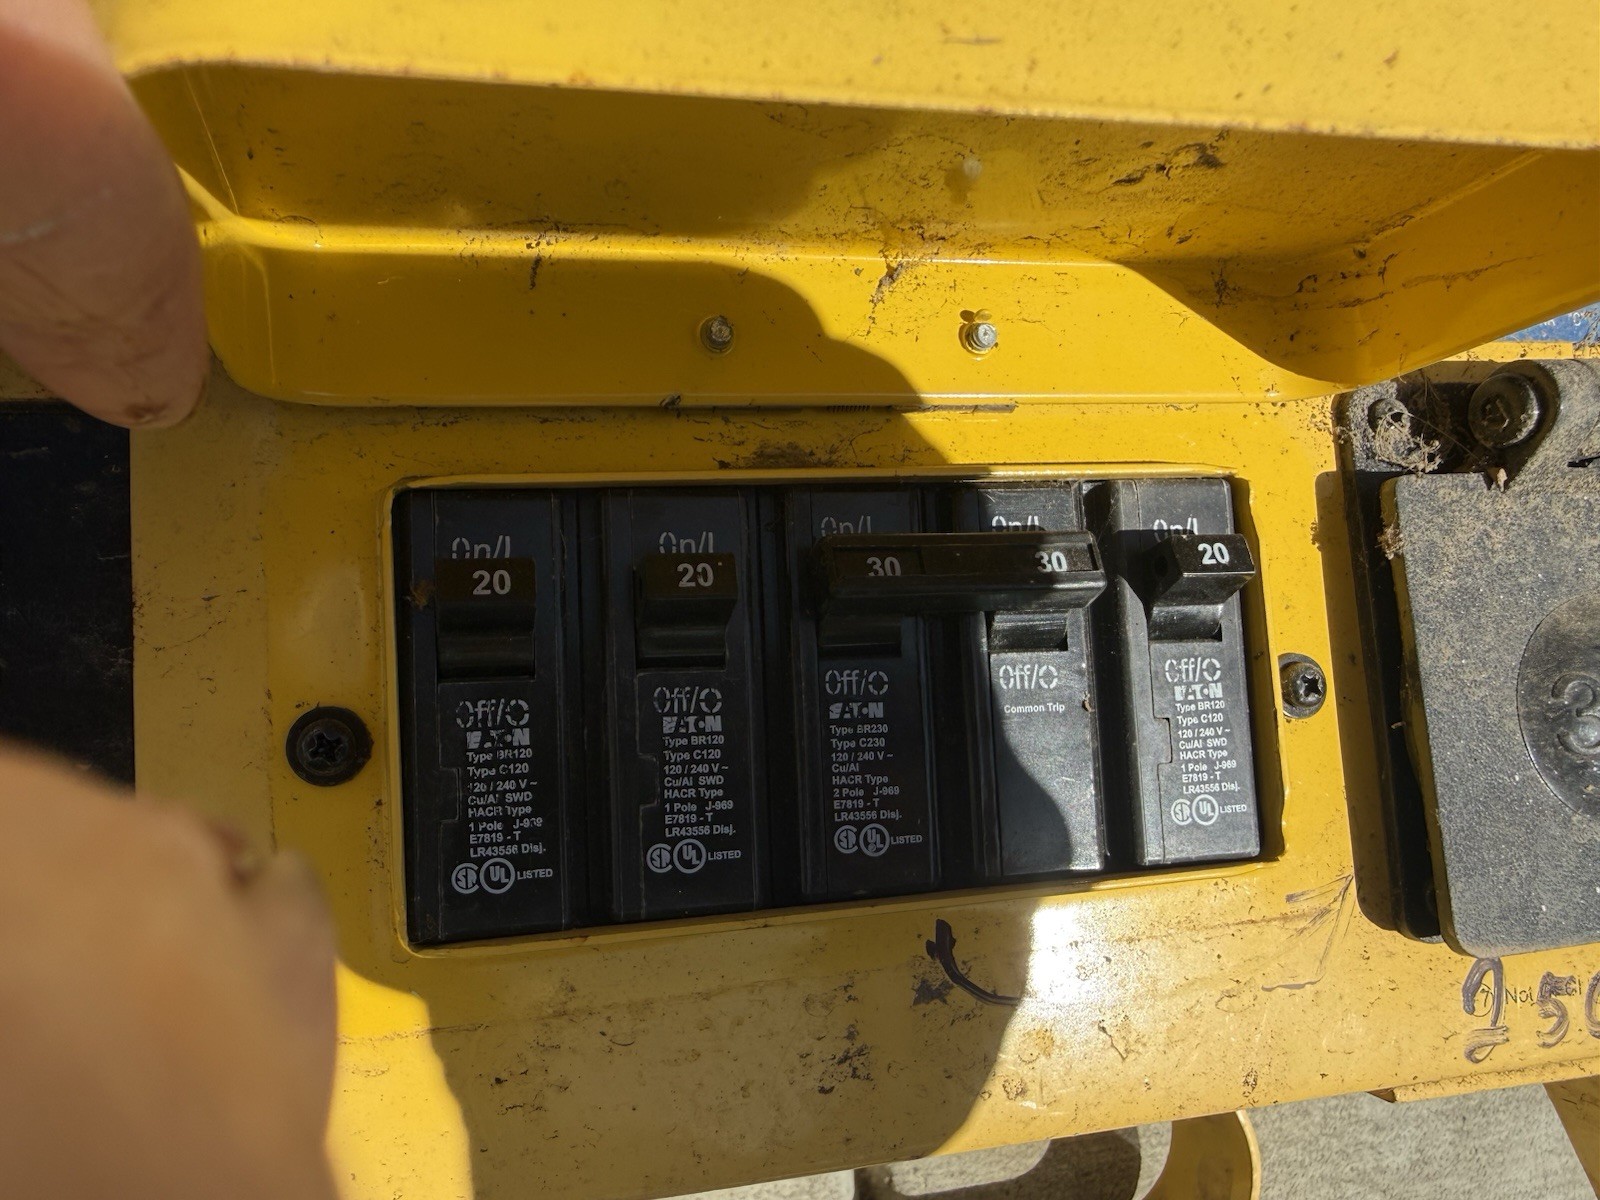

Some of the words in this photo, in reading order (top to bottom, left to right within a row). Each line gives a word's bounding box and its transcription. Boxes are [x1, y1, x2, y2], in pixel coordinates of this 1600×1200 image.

[1198, 543, 1230, 565] 20
[866, 556, 902, 577] 30
[1035, 551, 1068, 572] 30
[676, 562, 714, 588] 20
[472, 569, 512, 595] 20
[1004, 704, 1045, 714] Common
[1047, 703, 1065, 714] Trip
[1174, 703, 1196, 714] Type
[1197, 700, 1225, 710] BR120
[1176, 716, 1199, 727] Type
[1200, 713, 1224, 723] C120
[829, 725, 854, 736] Type
[856, 723, 889, 734] BR230
[1178, 729, 1193, 738] 120
[1199, 727, 1215, 737] 240
[1216, 726, 1223, 736] V
[662, 736, 688, 748] Type
[690, 735, 725, 746] BR120
[830, 738, 856, 750] Type
[859, 737, 886, 748] C230
[1206, 737, 1228, 747] SWD
[662, 750, 690, 763] Type
[692, 748, 722, 760] C120
[830, 752, 849, 762] 120
[857, 751, 875, 761] 240
[876, 751, 885, 761] V
[1179, 750, 1206, 760] HACR
[1207, 749, 1228, 760] Type
[499, 763, 529, 775] C120
[663, 764, 682, 775] 120
[690, 763, 709, 774] 240
[711, 762, 720, 773] V
[1180, 763, 1186, 772] 1
[1188, 763, 1208, 772] Pole
[1213, 759, 1237, 771] J-969
[698, 775, 724, 785] SWD
[832, 775, 863, 785] HACR
[864, 774, 889, 785] Type
[1181, 773, 1208, 783] E7819
[1215, 771, 1222, 780] T
[496, 779, 516, 791] 240
[518, 778, 527, 788] V
[1182, 784, 1220, 795] LR43556
[505, 791, 533, 803] SWD
[663, 788, 696, 799] HACR
[698, 787, 724, 800] Type
[833, 788, 840, 798] 2
[842, 787, 865, 798] Pole
[873, 786, 900, 796] J-969
[664, 803, 670, 812] 1
[673, 802, 697, 813] Pole
[704, 800, 734, 811] J-969
[833, 799, 864, 809] E7819
[872, 798, 880, 808] T
[1220, 804, 1247, 813] LISTED
[664, 813, 697, 825] E7819
[705, 812, 714, 822] T
[834, 811, 877, 822] LR43556
[469, 822, 474, 832] 1
[478, 820, 504, 832] Pole
[665, 825, 711, 838] LR43556
[469, 832, 503, 844] E7819
[512, 831, 521, 841] T
[890, 834, 923, 845] LISTED
[469, 845, 518, 858] LR43556
[707, 849, 742, 861] LISTED
[516, 868, 553, 880] LISTED
